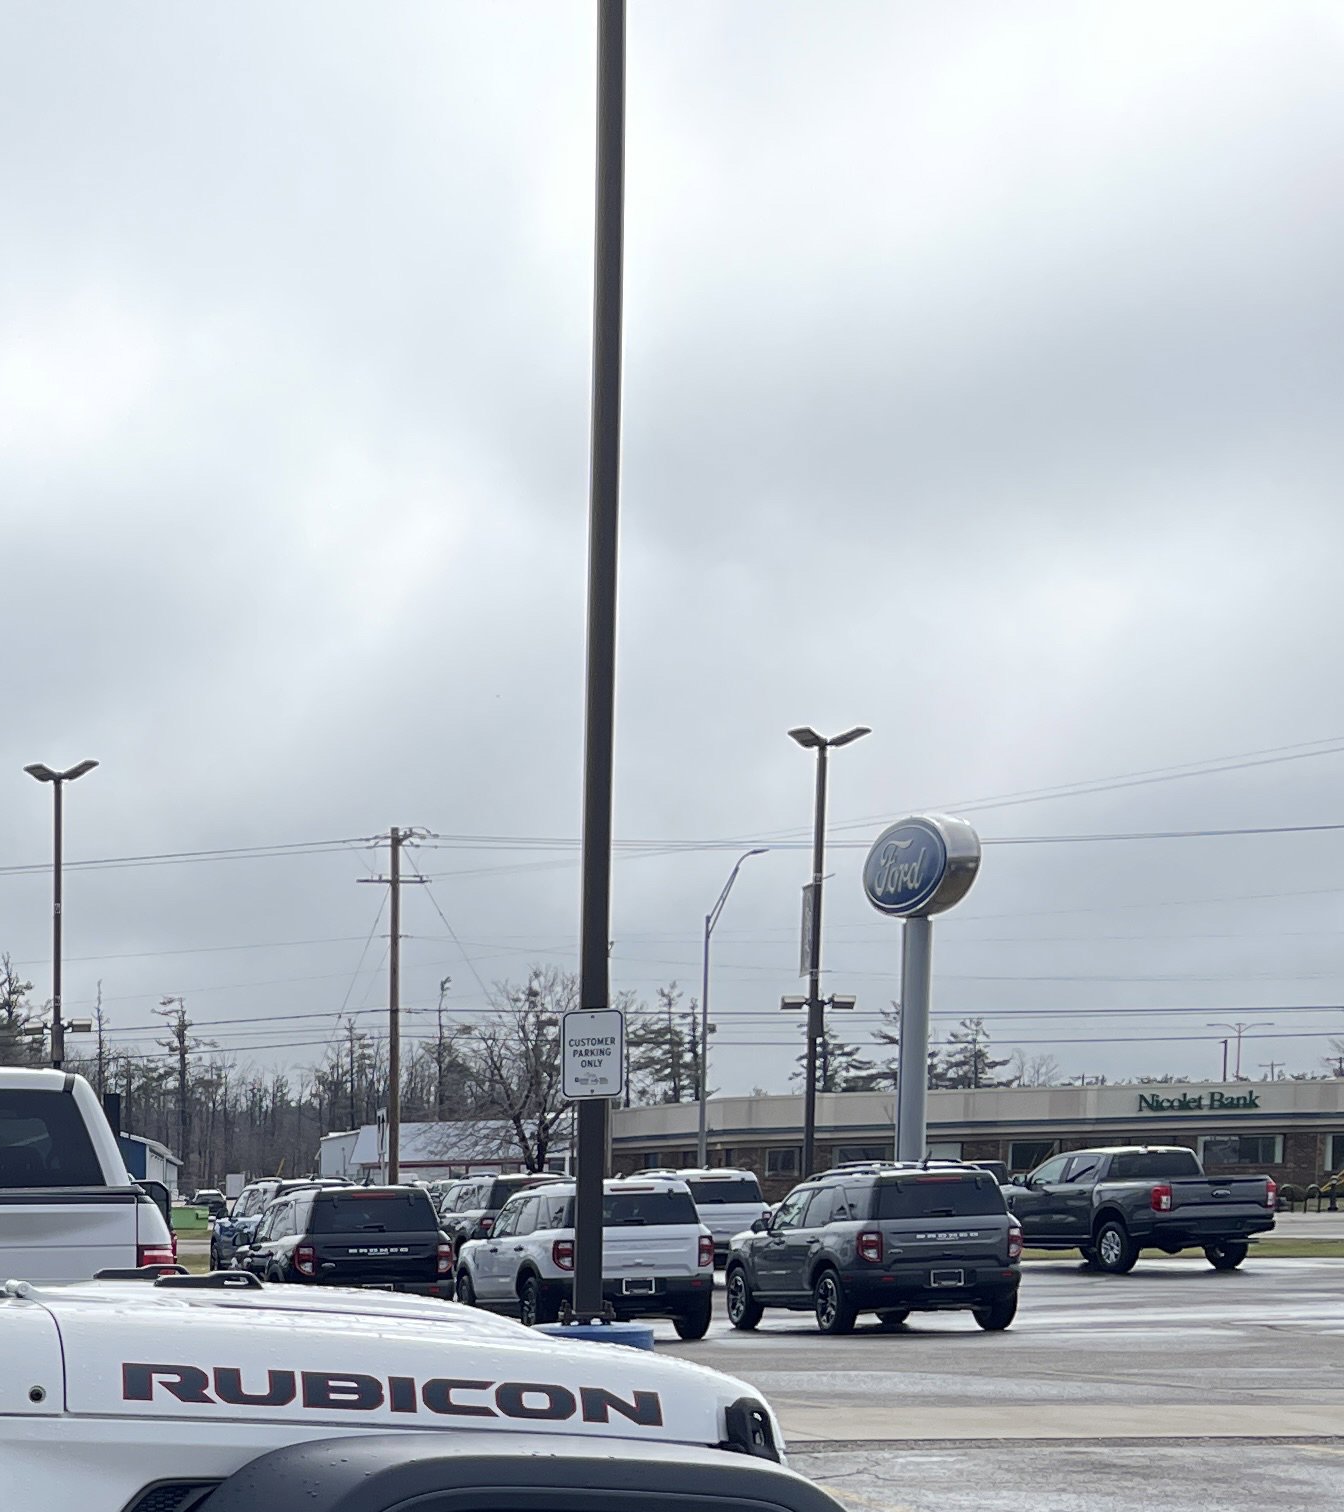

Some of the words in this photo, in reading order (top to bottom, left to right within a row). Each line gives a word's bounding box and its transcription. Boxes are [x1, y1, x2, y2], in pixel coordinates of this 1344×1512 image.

[875, 839, 926, 897] Ford
[568, 1037, 616, 1048] CUSTOMER
[572, 1048, 612, 1058] PARKING
[580, 1058, 603, 1068] ONLY
[1138, 1092, 1204, 1112] Nicolet
[1209, 1089, 1261, 1111] Bank
[122, 1362, 664, 1427] RUBICON
